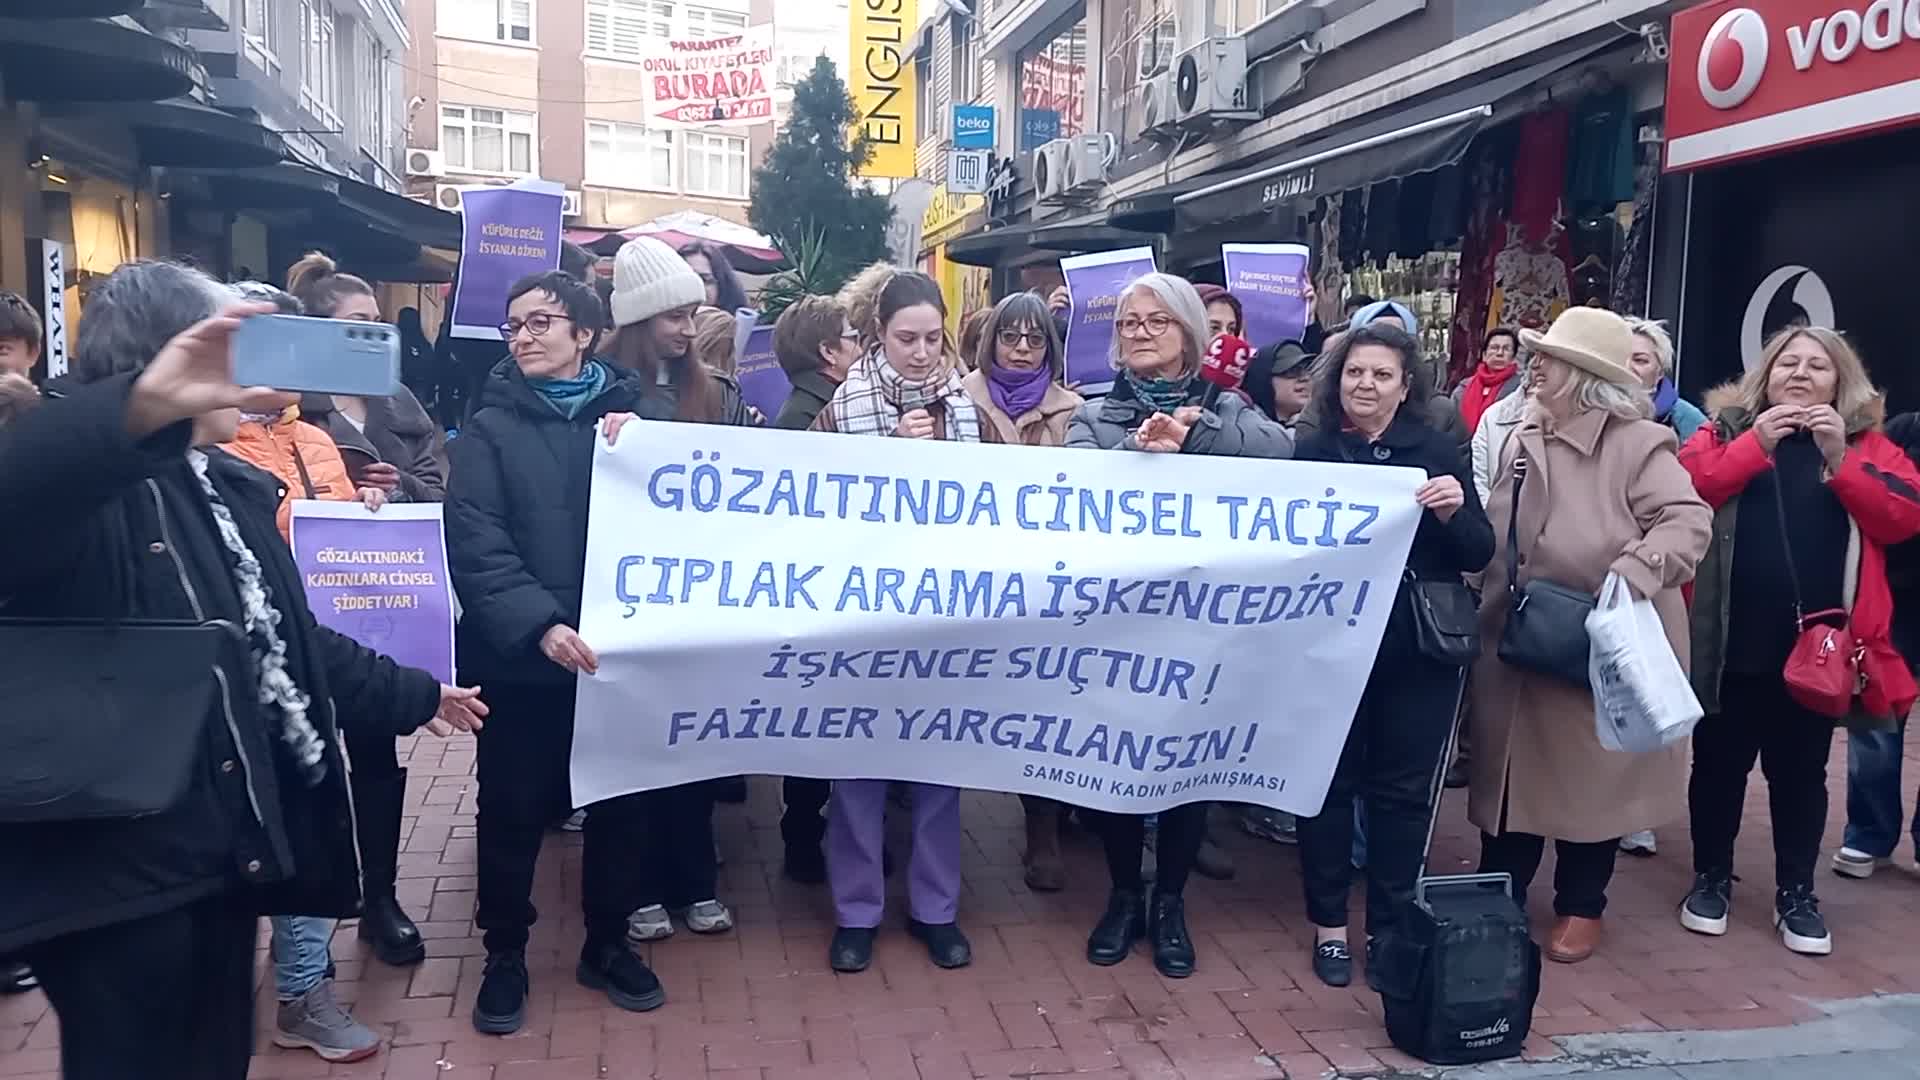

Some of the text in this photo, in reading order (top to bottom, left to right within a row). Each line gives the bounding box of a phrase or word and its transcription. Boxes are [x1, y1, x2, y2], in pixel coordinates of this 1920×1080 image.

[644, 58, 681, 71] OKUL
[654, 68, 766, 100] BURADA
[957, 116, 990, 129] beko
[1263, 168, 1314, 203] SEVİMLİ
[648, 450, 1379, 548] GÖZALTINDA CİNSEL TACİZ
[307, 571, 436, 588] KADINLARA CİNSEL
[615, 555, 824, 618] ÇIPLAK
[835, 566, 1026, 617] ARAMA
[333, 594, 382, 614] ŞİDDET
[763, 644, 998, 688] İŞKENCE
[667, 699, 1258, 772] FAİLLER YARGILANSIN!
[1023, 764, 1286, 799] SAMSUN KADIN DAYANIŞMASI
